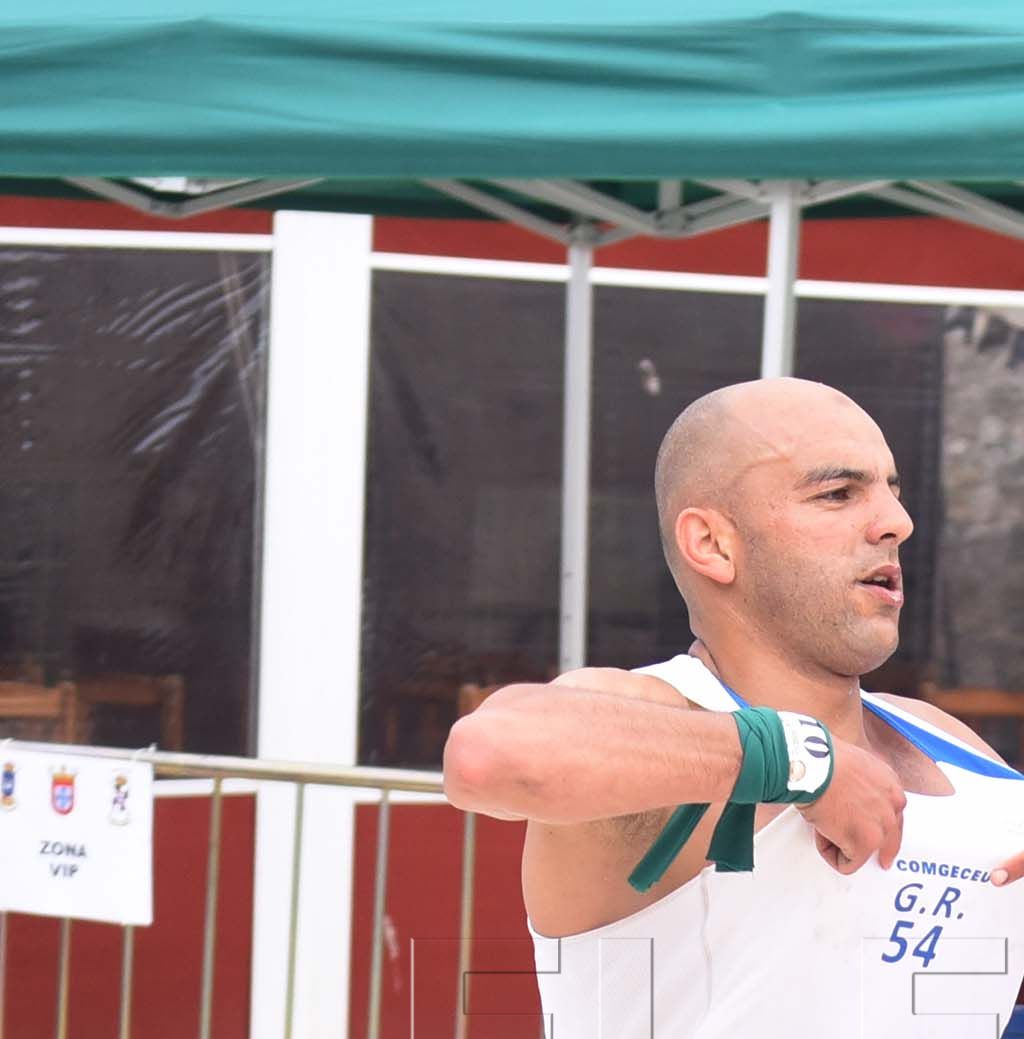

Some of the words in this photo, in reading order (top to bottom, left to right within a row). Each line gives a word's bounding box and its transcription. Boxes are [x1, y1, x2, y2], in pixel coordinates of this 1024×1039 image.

[40, 840, 87, 858] ZONA
[50, 863, 79, 878] VIP
[894, 883, 964, 920] G.R.
[881, 920, 944, 968] 54
